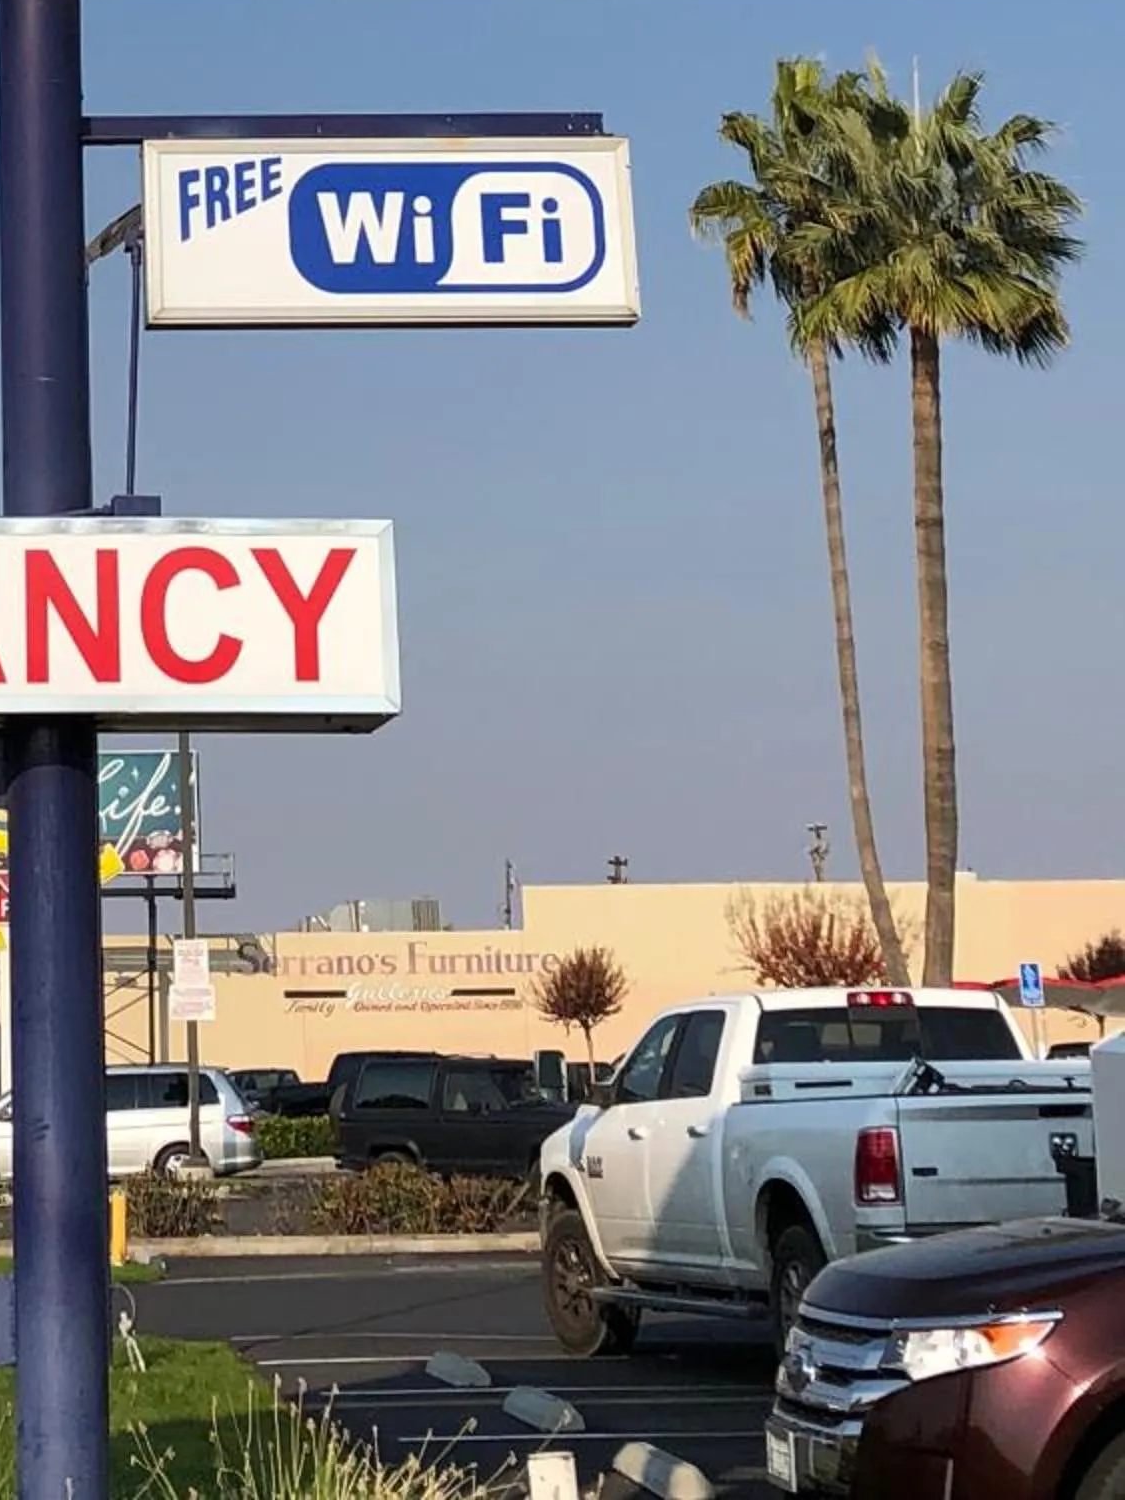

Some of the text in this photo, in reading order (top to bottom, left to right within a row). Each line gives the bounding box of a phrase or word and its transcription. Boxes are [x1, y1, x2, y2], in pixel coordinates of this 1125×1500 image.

[178, 157, 283, 242] FREE
[238, 941, 398, 976] Serrano's
[408, 940, 561, 975] Furniture
